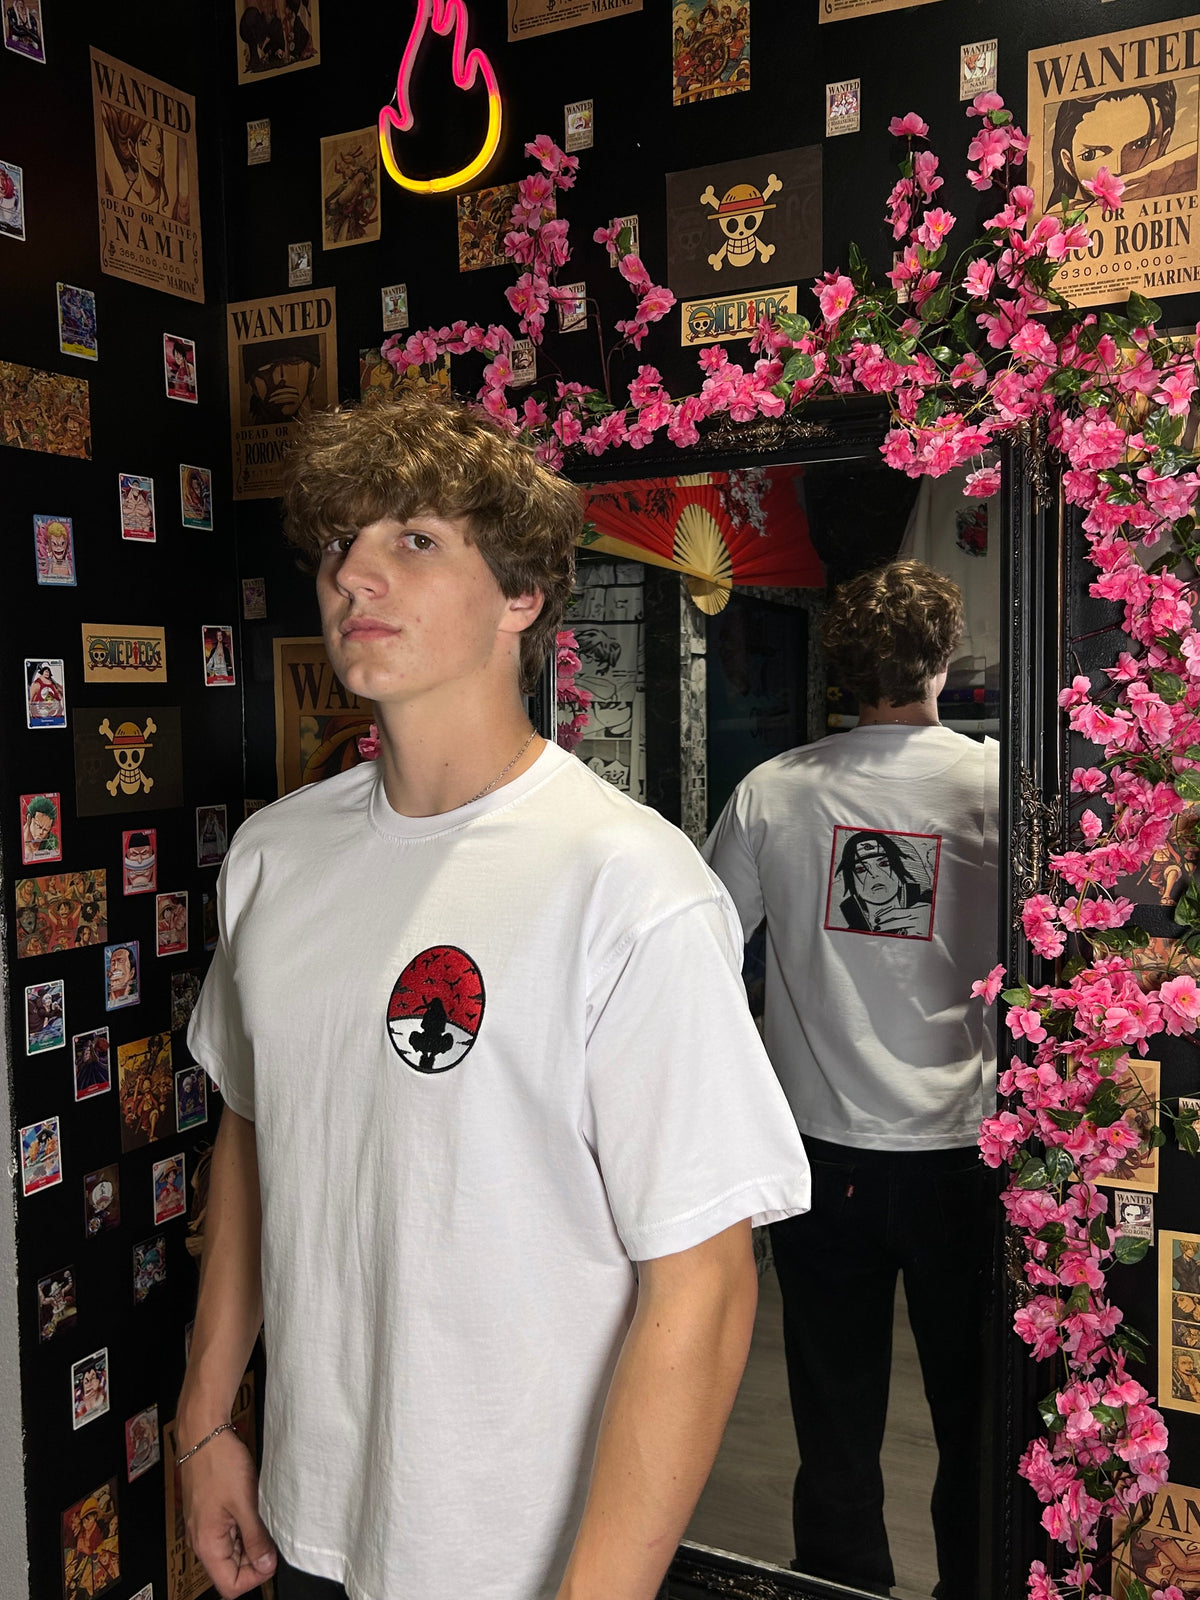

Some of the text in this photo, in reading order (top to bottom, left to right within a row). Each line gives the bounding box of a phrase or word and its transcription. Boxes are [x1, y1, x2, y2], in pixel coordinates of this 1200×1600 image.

[963, 41, 997, 56] WANTED
[91, 58, 191, 133] WANTED
[828, 81, 859, 94] WANTED
[566, 102, 593, 113] WANTED
[106, 198, 192, 241] DEAD OR ALIVE
[1101, 195, 1199, 223] OR ALIVE
[115, 215, 185, 264] NAMI
[1114, 214, 1192, 256] ROBIN
[167, 275, 198, 295] MARINE
[1143, 266, 1200, 288] MARINE
[231, 298, 332, 340] WANTED
[241, 426, 288, 441] DEAD OR
[287, 662, 362, 710] WA
[1117, 1194, 1152, 1205] WANTED
